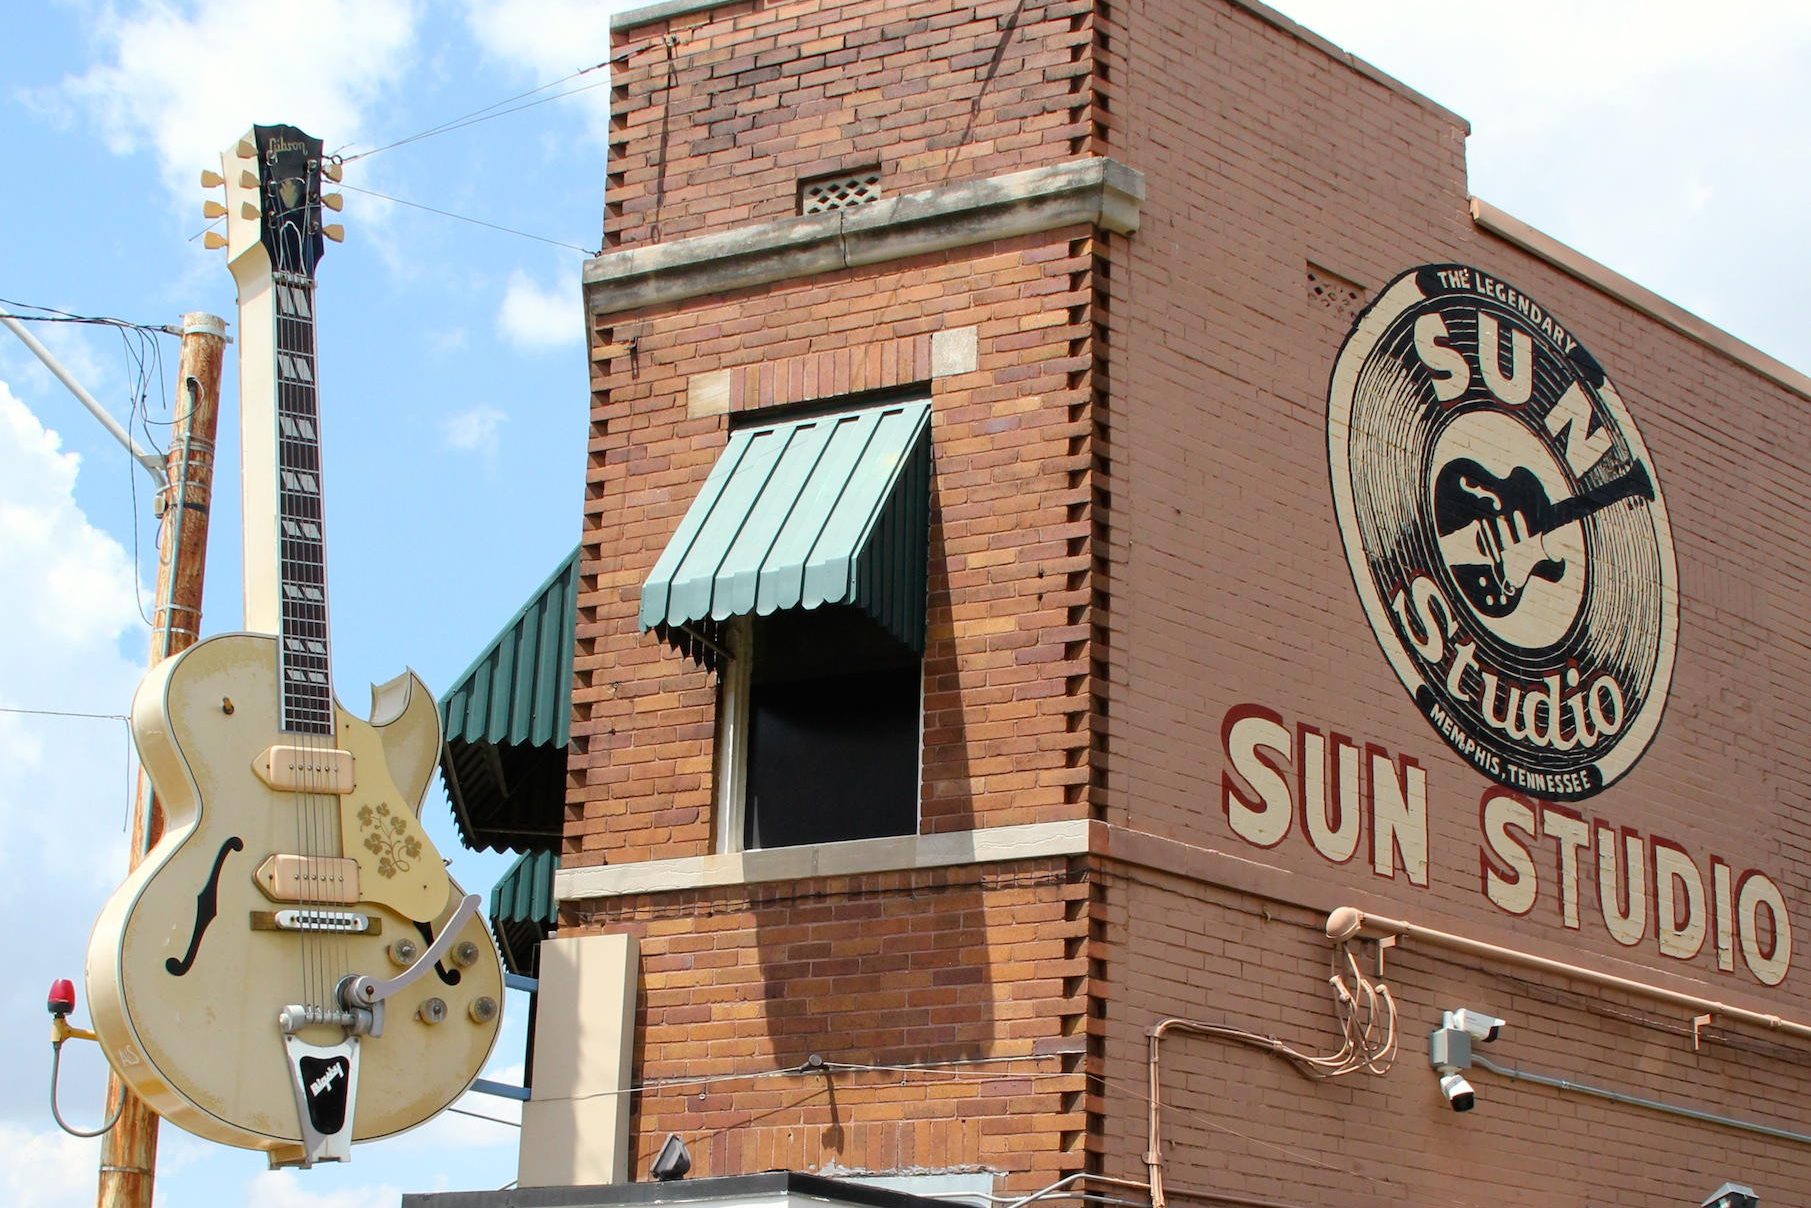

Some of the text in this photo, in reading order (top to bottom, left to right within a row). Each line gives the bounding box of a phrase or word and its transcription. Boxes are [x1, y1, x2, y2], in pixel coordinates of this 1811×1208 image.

[1437, 269, 1577, 354] THE LEGENDARY
[1413, 312, 1614, 481] SUN
[1392, 576, 1624, 751] Studio
[1221, 704, 1793, 986] SUN STUDIO
[1507, 764, 1591, 794] TENNESSEE
